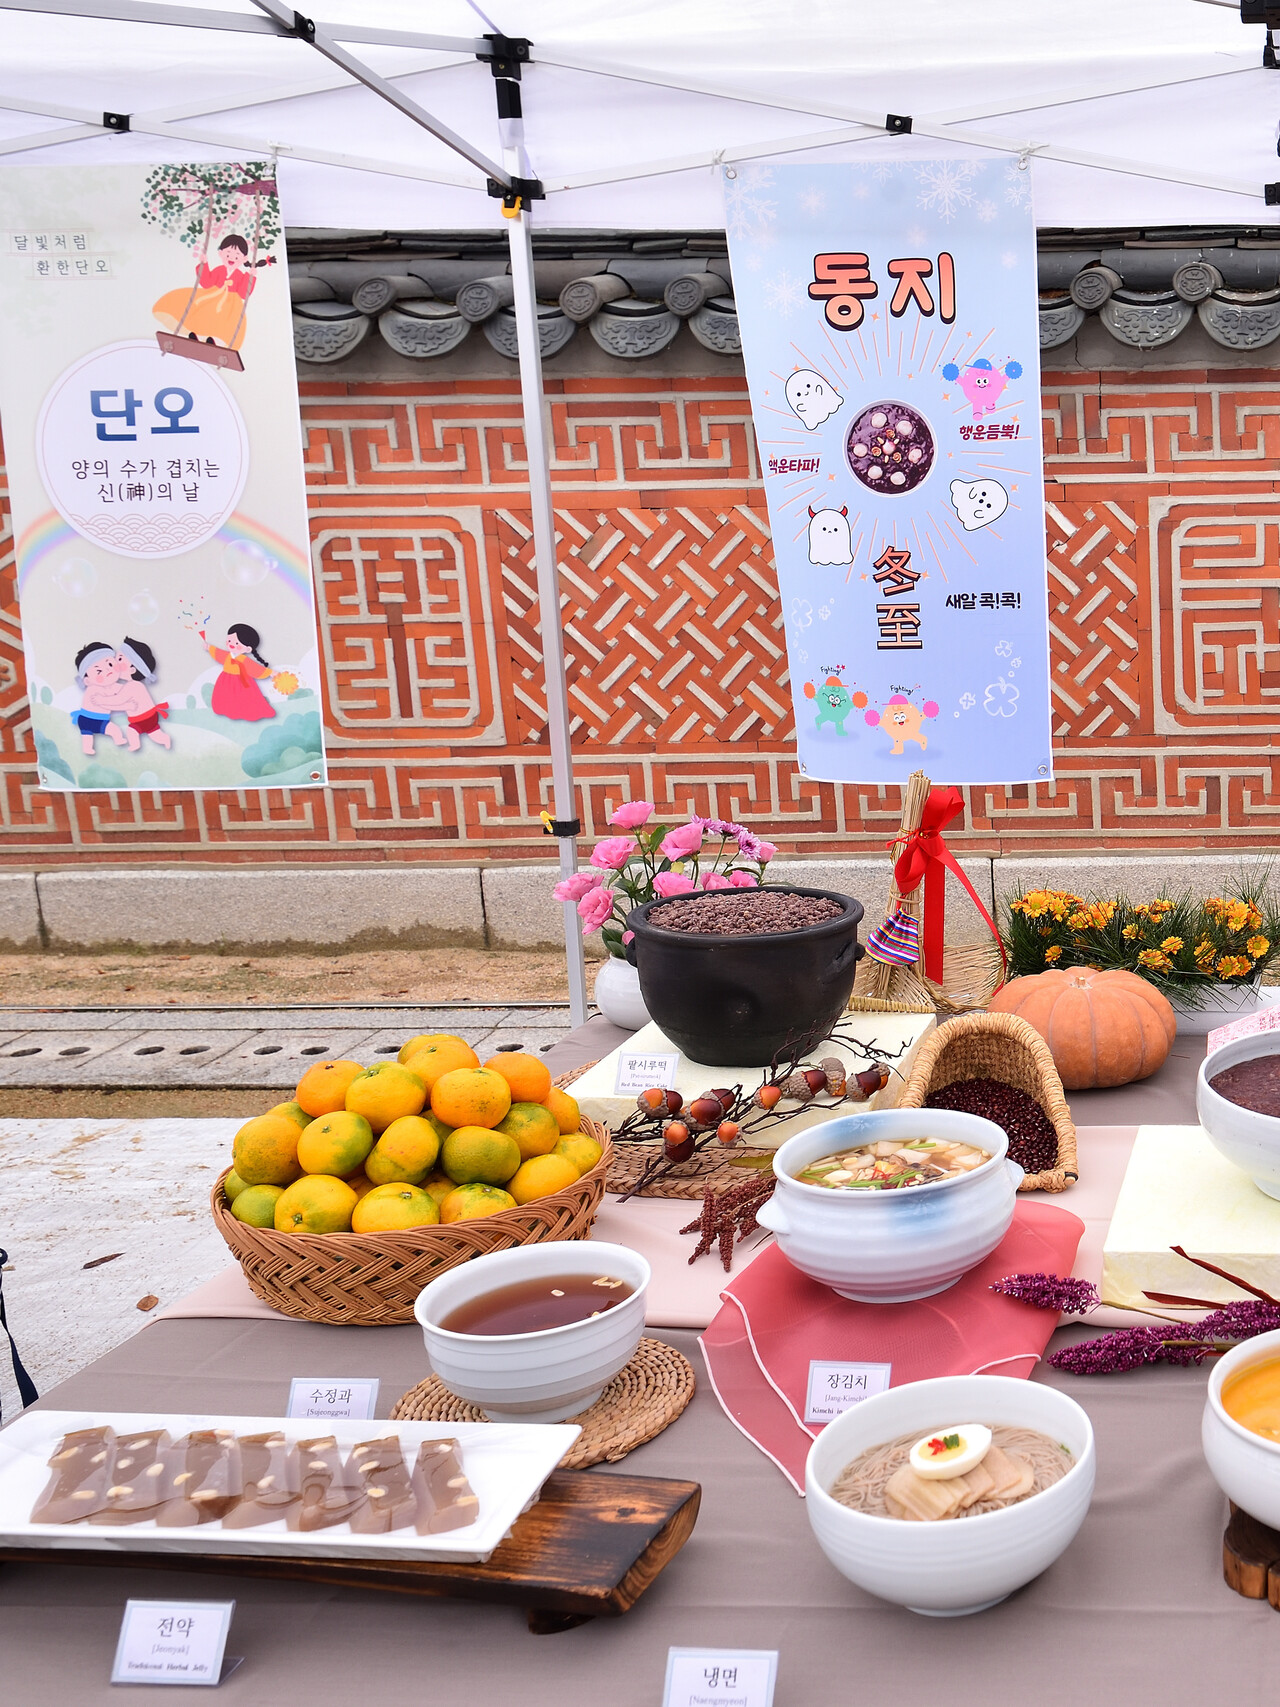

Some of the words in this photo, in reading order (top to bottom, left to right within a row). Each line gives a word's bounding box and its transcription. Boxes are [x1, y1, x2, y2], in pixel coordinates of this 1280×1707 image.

[14, 234, 86, 250] 달빛처럼
[37, 259, 108, 275] 환한단오
[807, 251, 957, 332] 동지
[90, 387, 200, 441] 단오
[959, 424, 1020, 441] 행운듬뿍!
[71, 459, 109, 480] 양의
[120, 459, 157, 479] 수가
[166, 458, 220, 479] 겹치는
[768, 458, 820, 474] 액운타파!
[98, 482, 172, 503] 신(神)의
[182, 482, 200, 502] 날
[872, 546, 924, 650] 冬至
[945, 593, 977, 610] 새알
[979, 592, 1021, 609] 콕!콕!
[820, 666, 841, 676] Fighting!
[890, 684, 914, 695] Fighting!
[628, 1060, 667, 1070] 팥시루떡
[828, 1374, 867, 1390] 장김치
[310, 1389, 352, 1403] 수정과
[306, 1409, 350, 1417] [Sujeonggwa]
[157, 1617, 195, 1638] 전약
[704, 1667, 737, 1688] 냉면
